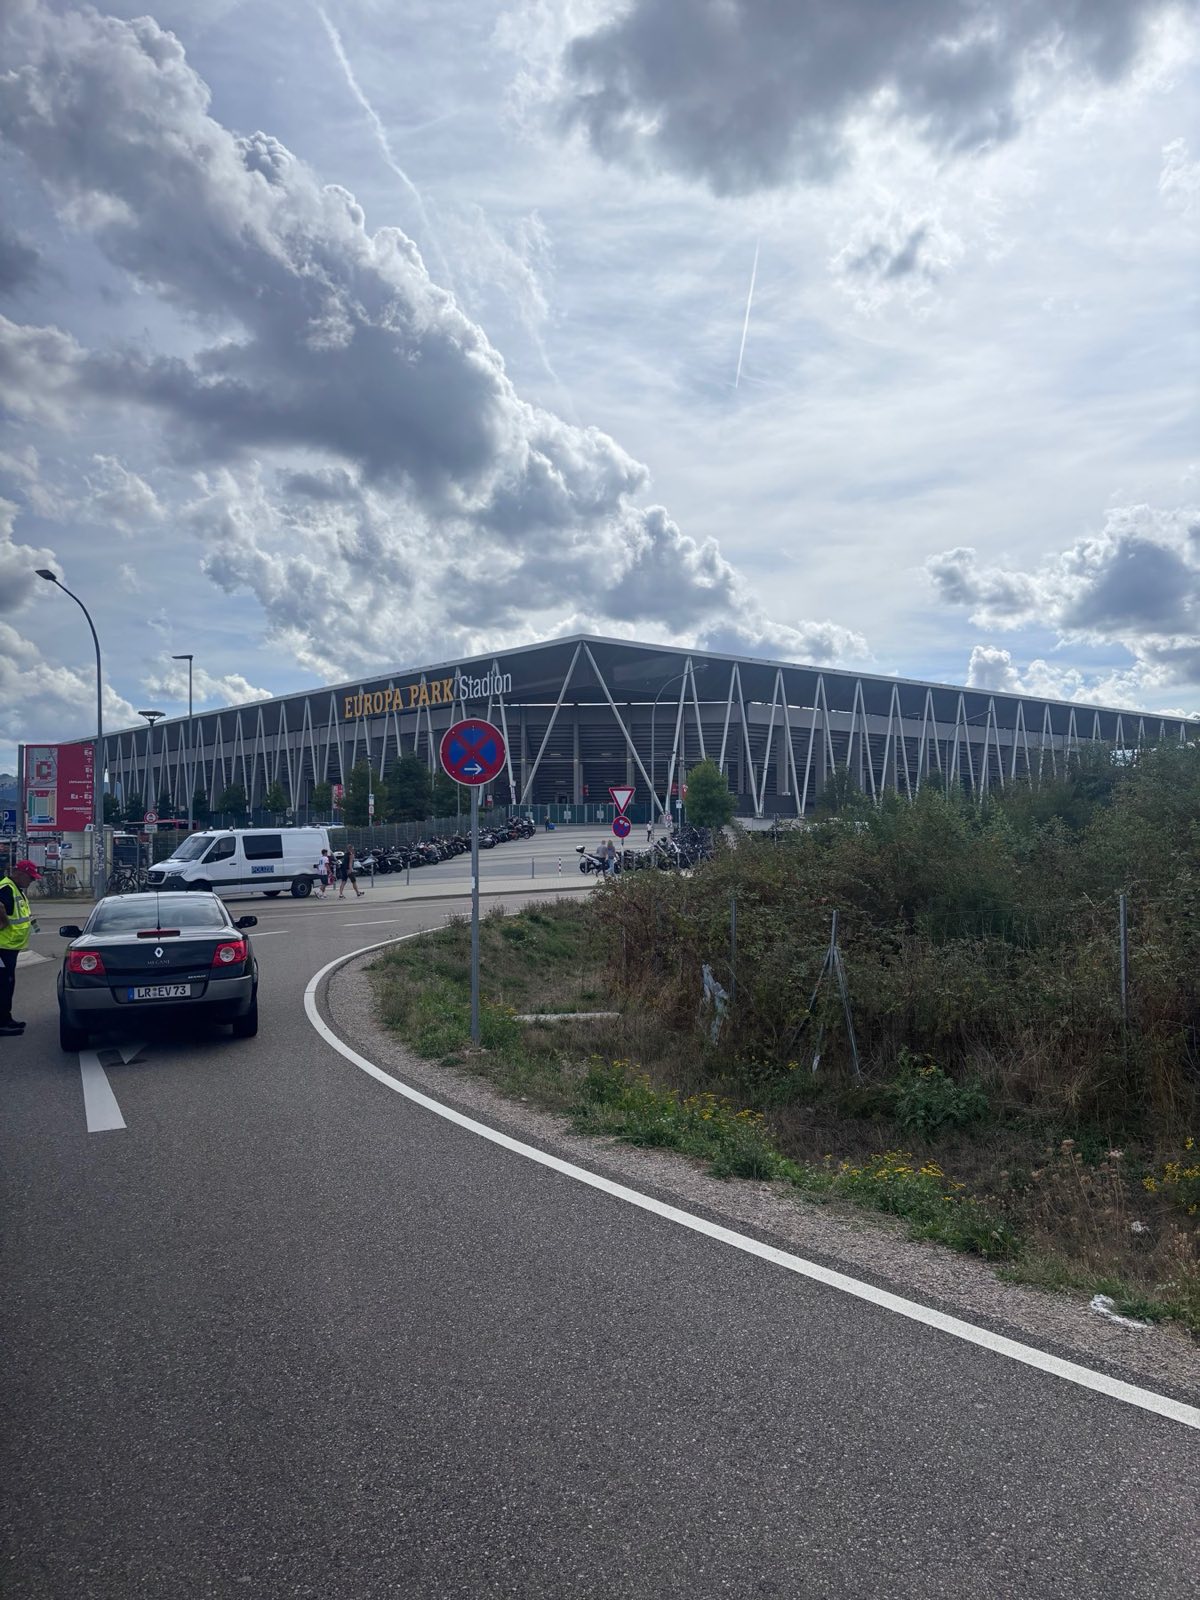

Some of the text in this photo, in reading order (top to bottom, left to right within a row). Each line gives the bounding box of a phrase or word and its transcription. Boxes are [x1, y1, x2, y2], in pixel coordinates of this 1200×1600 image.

[344, 672, 511, 717] EUROPA PARK Stadion
[138, 988, 151, 998] LR
